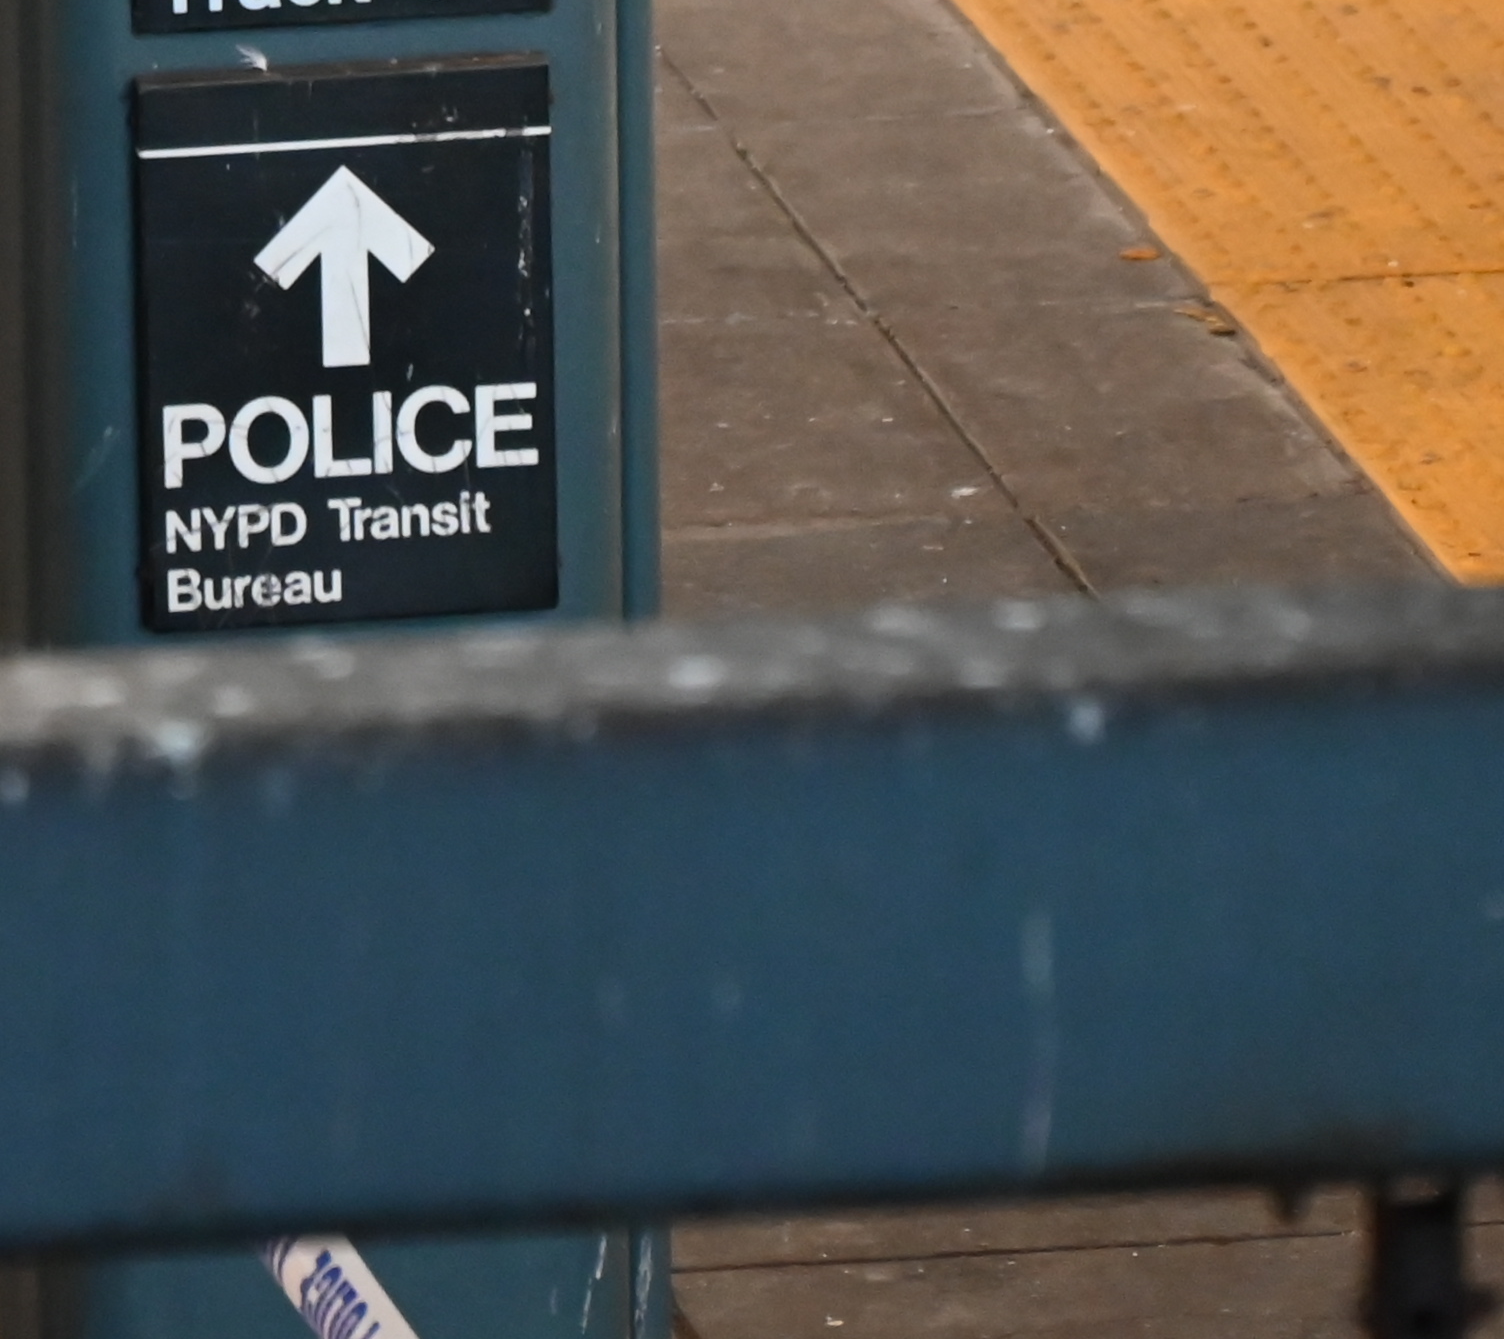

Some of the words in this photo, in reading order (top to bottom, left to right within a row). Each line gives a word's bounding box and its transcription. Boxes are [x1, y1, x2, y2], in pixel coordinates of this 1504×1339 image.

[162, 381, 539, 489] POLICE
[165, 501, 308, 555] NYPD
[327, 490, 491, 542] Transit
[167, 566, 343, 614] Bureau
